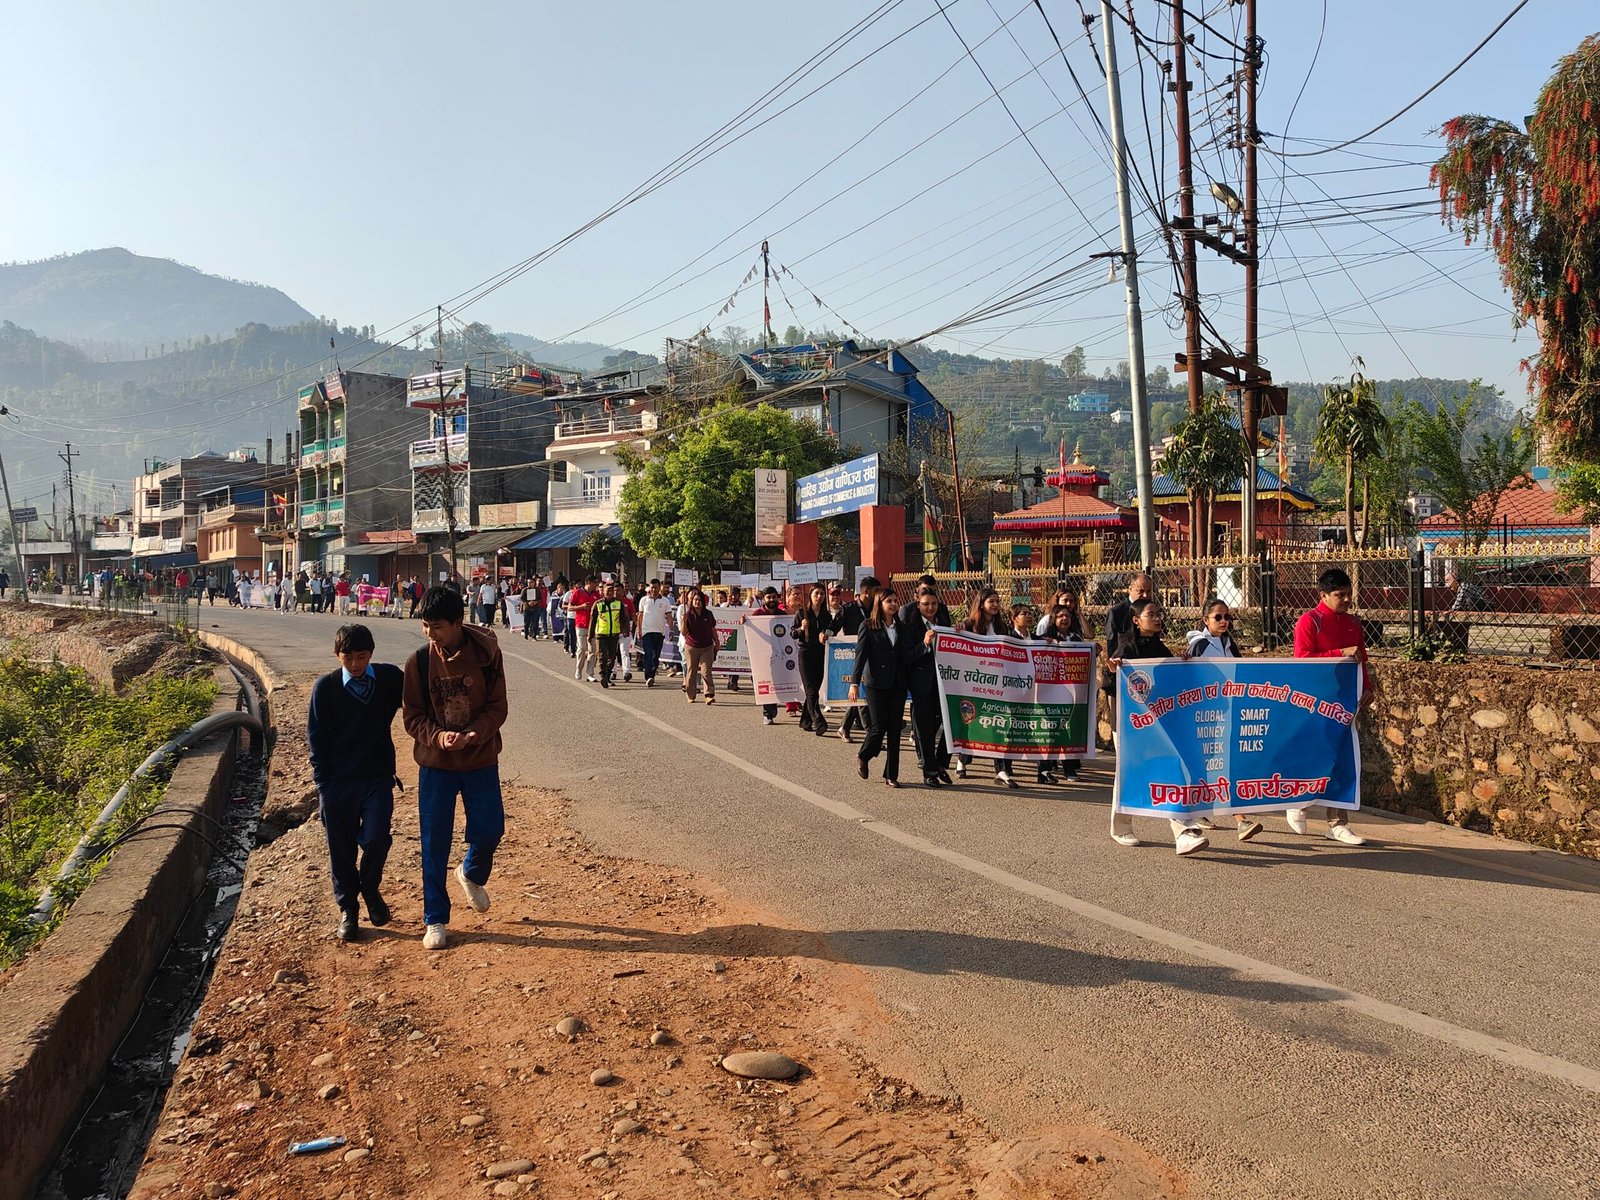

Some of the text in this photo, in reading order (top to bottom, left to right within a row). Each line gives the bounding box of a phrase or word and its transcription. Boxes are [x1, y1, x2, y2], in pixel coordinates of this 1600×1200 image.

[863, 465, 876, 482] संघ
[940, 640, 972, 652] GLOBAL
[972, 645, 1000, 655] MONEY
[1064, 656, 1088, 664] SMART
[963, 668, 998, 685] सचेतना
[1177, 689, 1203, 707] संस्था
[1205, 682, 1219, 700] एवं
[1222, 680, 1246, 697] बीमा
[1248, 681, 1291, 702] कर्मचारी
[1290, 690, 1317, 714] क्लब,
[1046, 707, 1060, 715] Bank
[1195, 710, 1226, 723] GLOBAL
[1240, 708, 1270, 721] SMART
[979, 715, 1007, 728] कृषि
[1009, 716, 1037, 730] विकास
[1196, 725, 1226, 739] MONEY
[1240, 724, 1270, 737] MONEY
[1202, 742, 1224, 755] WEEK
[1239, 740, 1264, 752] TALKS
[1205, 758, 1224, 771] 2026
[1150, 773, 1331, 806] प्रभातफेरी कार्यक्रम
